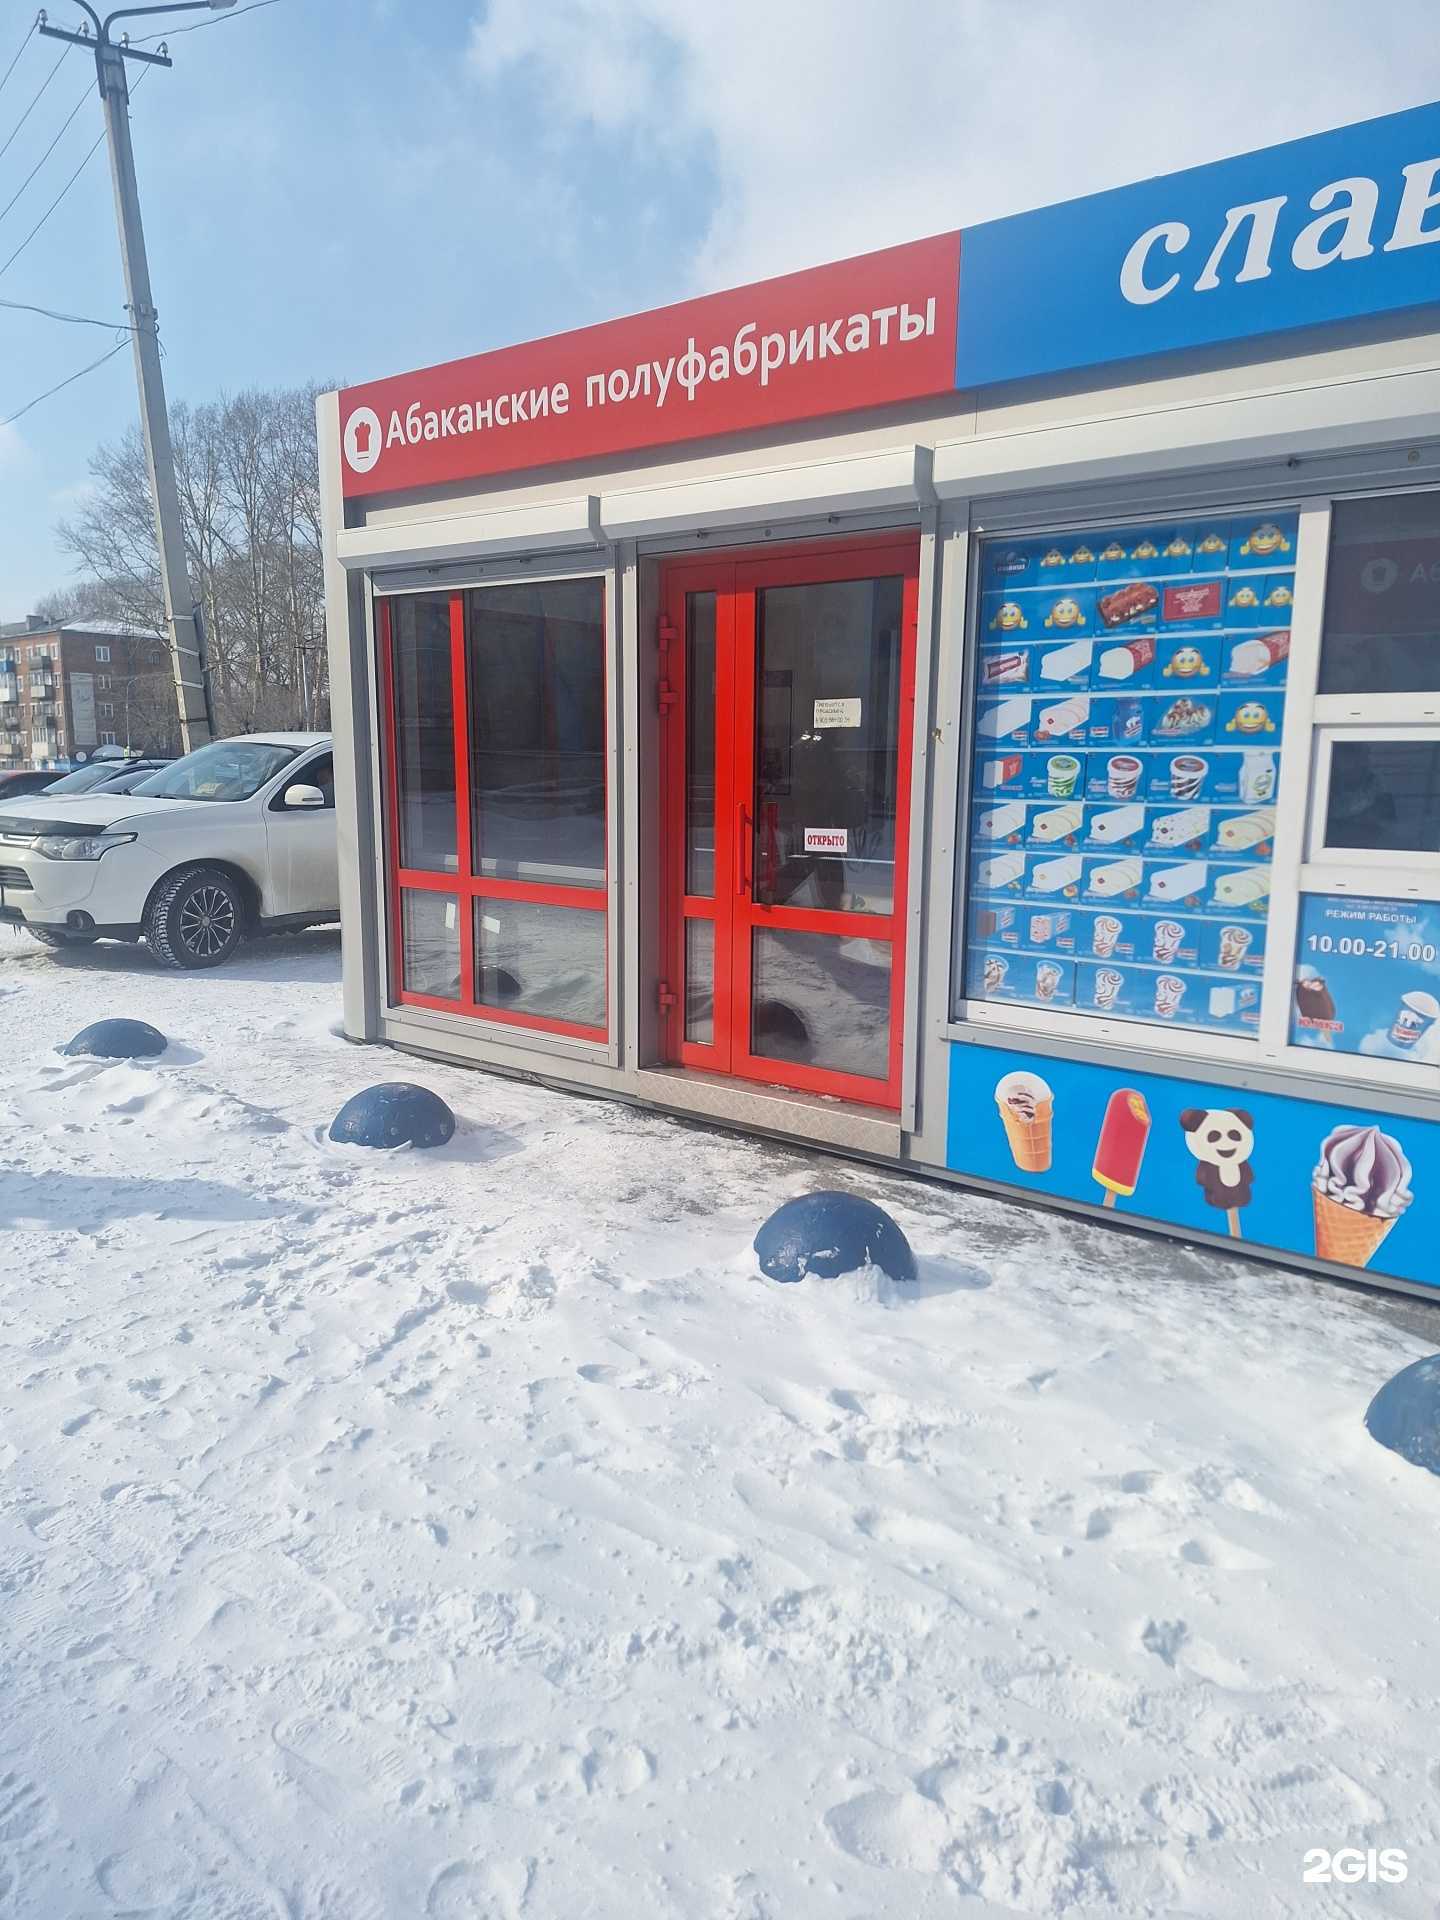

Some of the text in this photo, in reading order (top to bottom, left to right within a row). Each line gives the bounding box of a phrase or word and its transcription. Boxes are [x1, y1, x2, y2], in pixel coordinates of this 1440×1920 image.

[1120, 157, 1440, 305] слав
[385, 297, 938, 448] Абаканские полуфабрикаты
[807, 834, 845, 846] ОТКРЫТО
[1325, 909, 1417, 924] РЕЖИМ РАБОТЫ
[1307, 934, 1436, 962] 10.00-21.00
